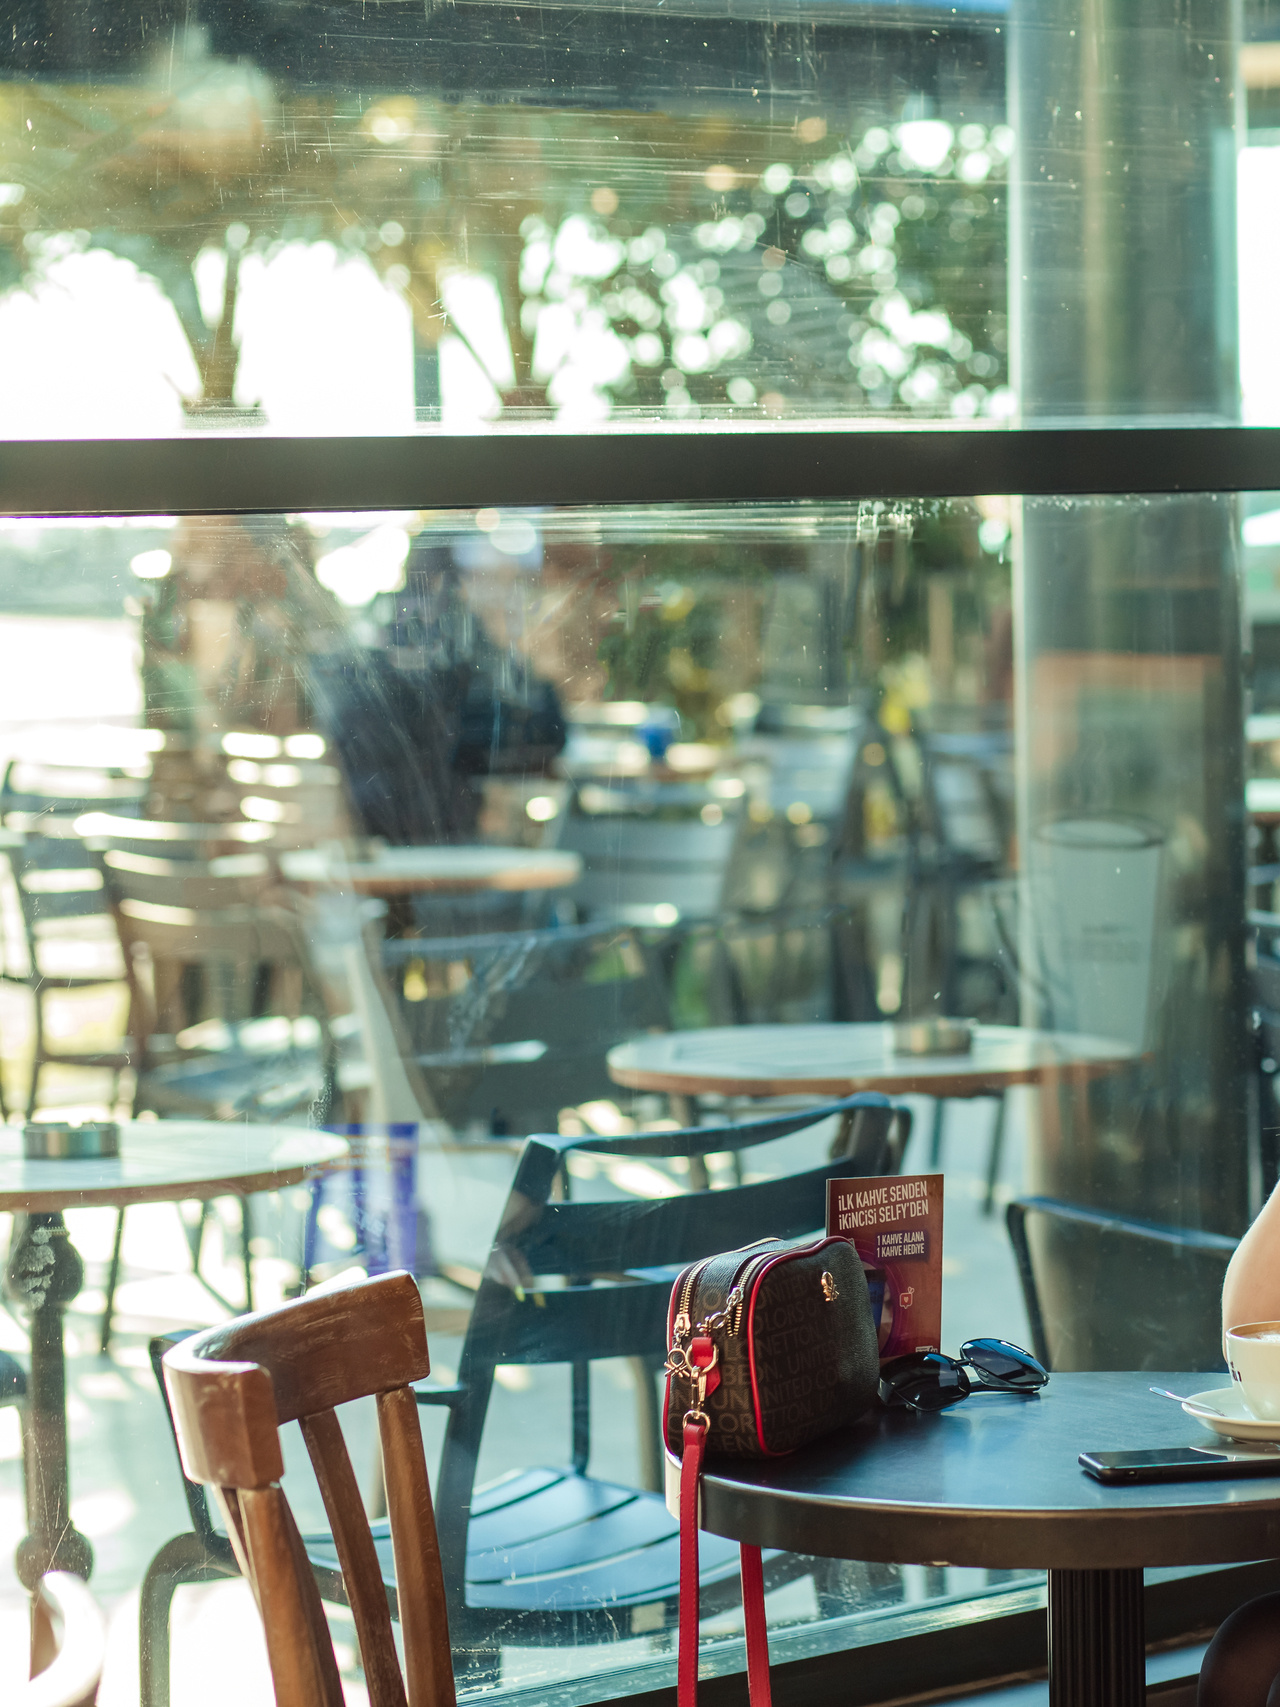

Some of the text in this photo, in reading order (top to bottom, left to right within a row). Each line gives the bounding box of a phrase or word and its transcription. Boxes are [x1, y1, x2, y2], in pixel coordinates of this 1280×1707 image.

[855, 1187, 889, 1209] KAHVE
[890, 1180, 928, 1202] SENDEN
[879, 1199, 929, 1223] SELFY'DEN
[881, 1233, 903, 1246] KAHVE
[903, 1230, 925, 1243] ALANA
[881, 1245, 903, 1258] KAHVE
